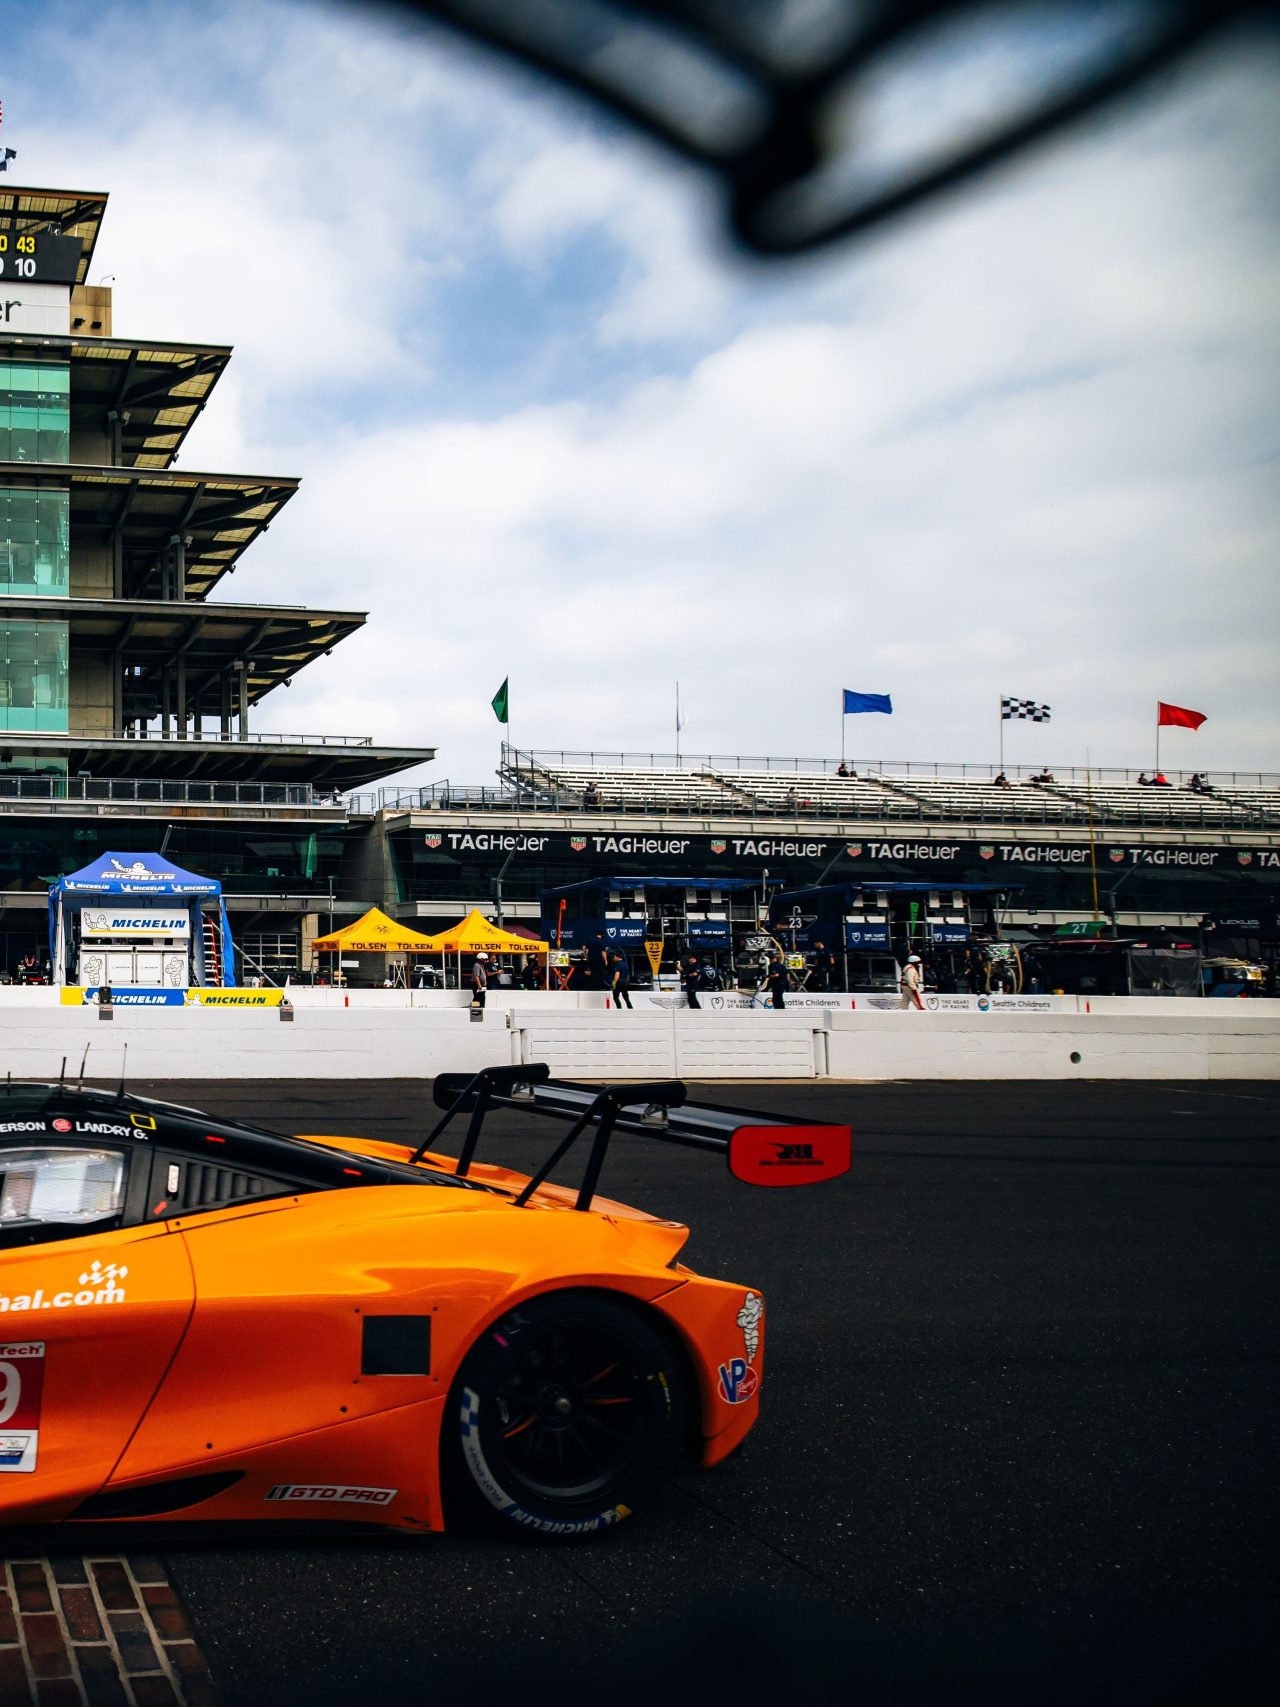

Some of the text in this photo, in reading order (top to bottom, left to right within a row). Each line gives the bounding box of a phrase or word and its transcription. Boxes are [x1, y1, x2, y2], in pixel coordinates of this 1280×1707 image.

[16, 236, 35, 254] 43
[15, 258, 36, 277] 10
[101, 872, 176, 880] MICHELIN
[111, 919, 187, 929] MICHELIN
[788, 918, 802, 928] 23
[1072, 923, 1088, 933] 27
[350, 942, 387, 950] TOLSEN
[509, 943, 540, 951] TOLSEN
[205, 996, 266, 1004] MICHELIN
[783, 998, 841, 1006] eattle Children's
[1017, 1000, 1051, 1008] Children's
[75, 1121, 131, 1137] LANDRY
[720, 1359, 746, 1402] VP
[289, 1487, 390, 1502] GTD PRO
[510, 1508, 599, 1534] MICHELIN
